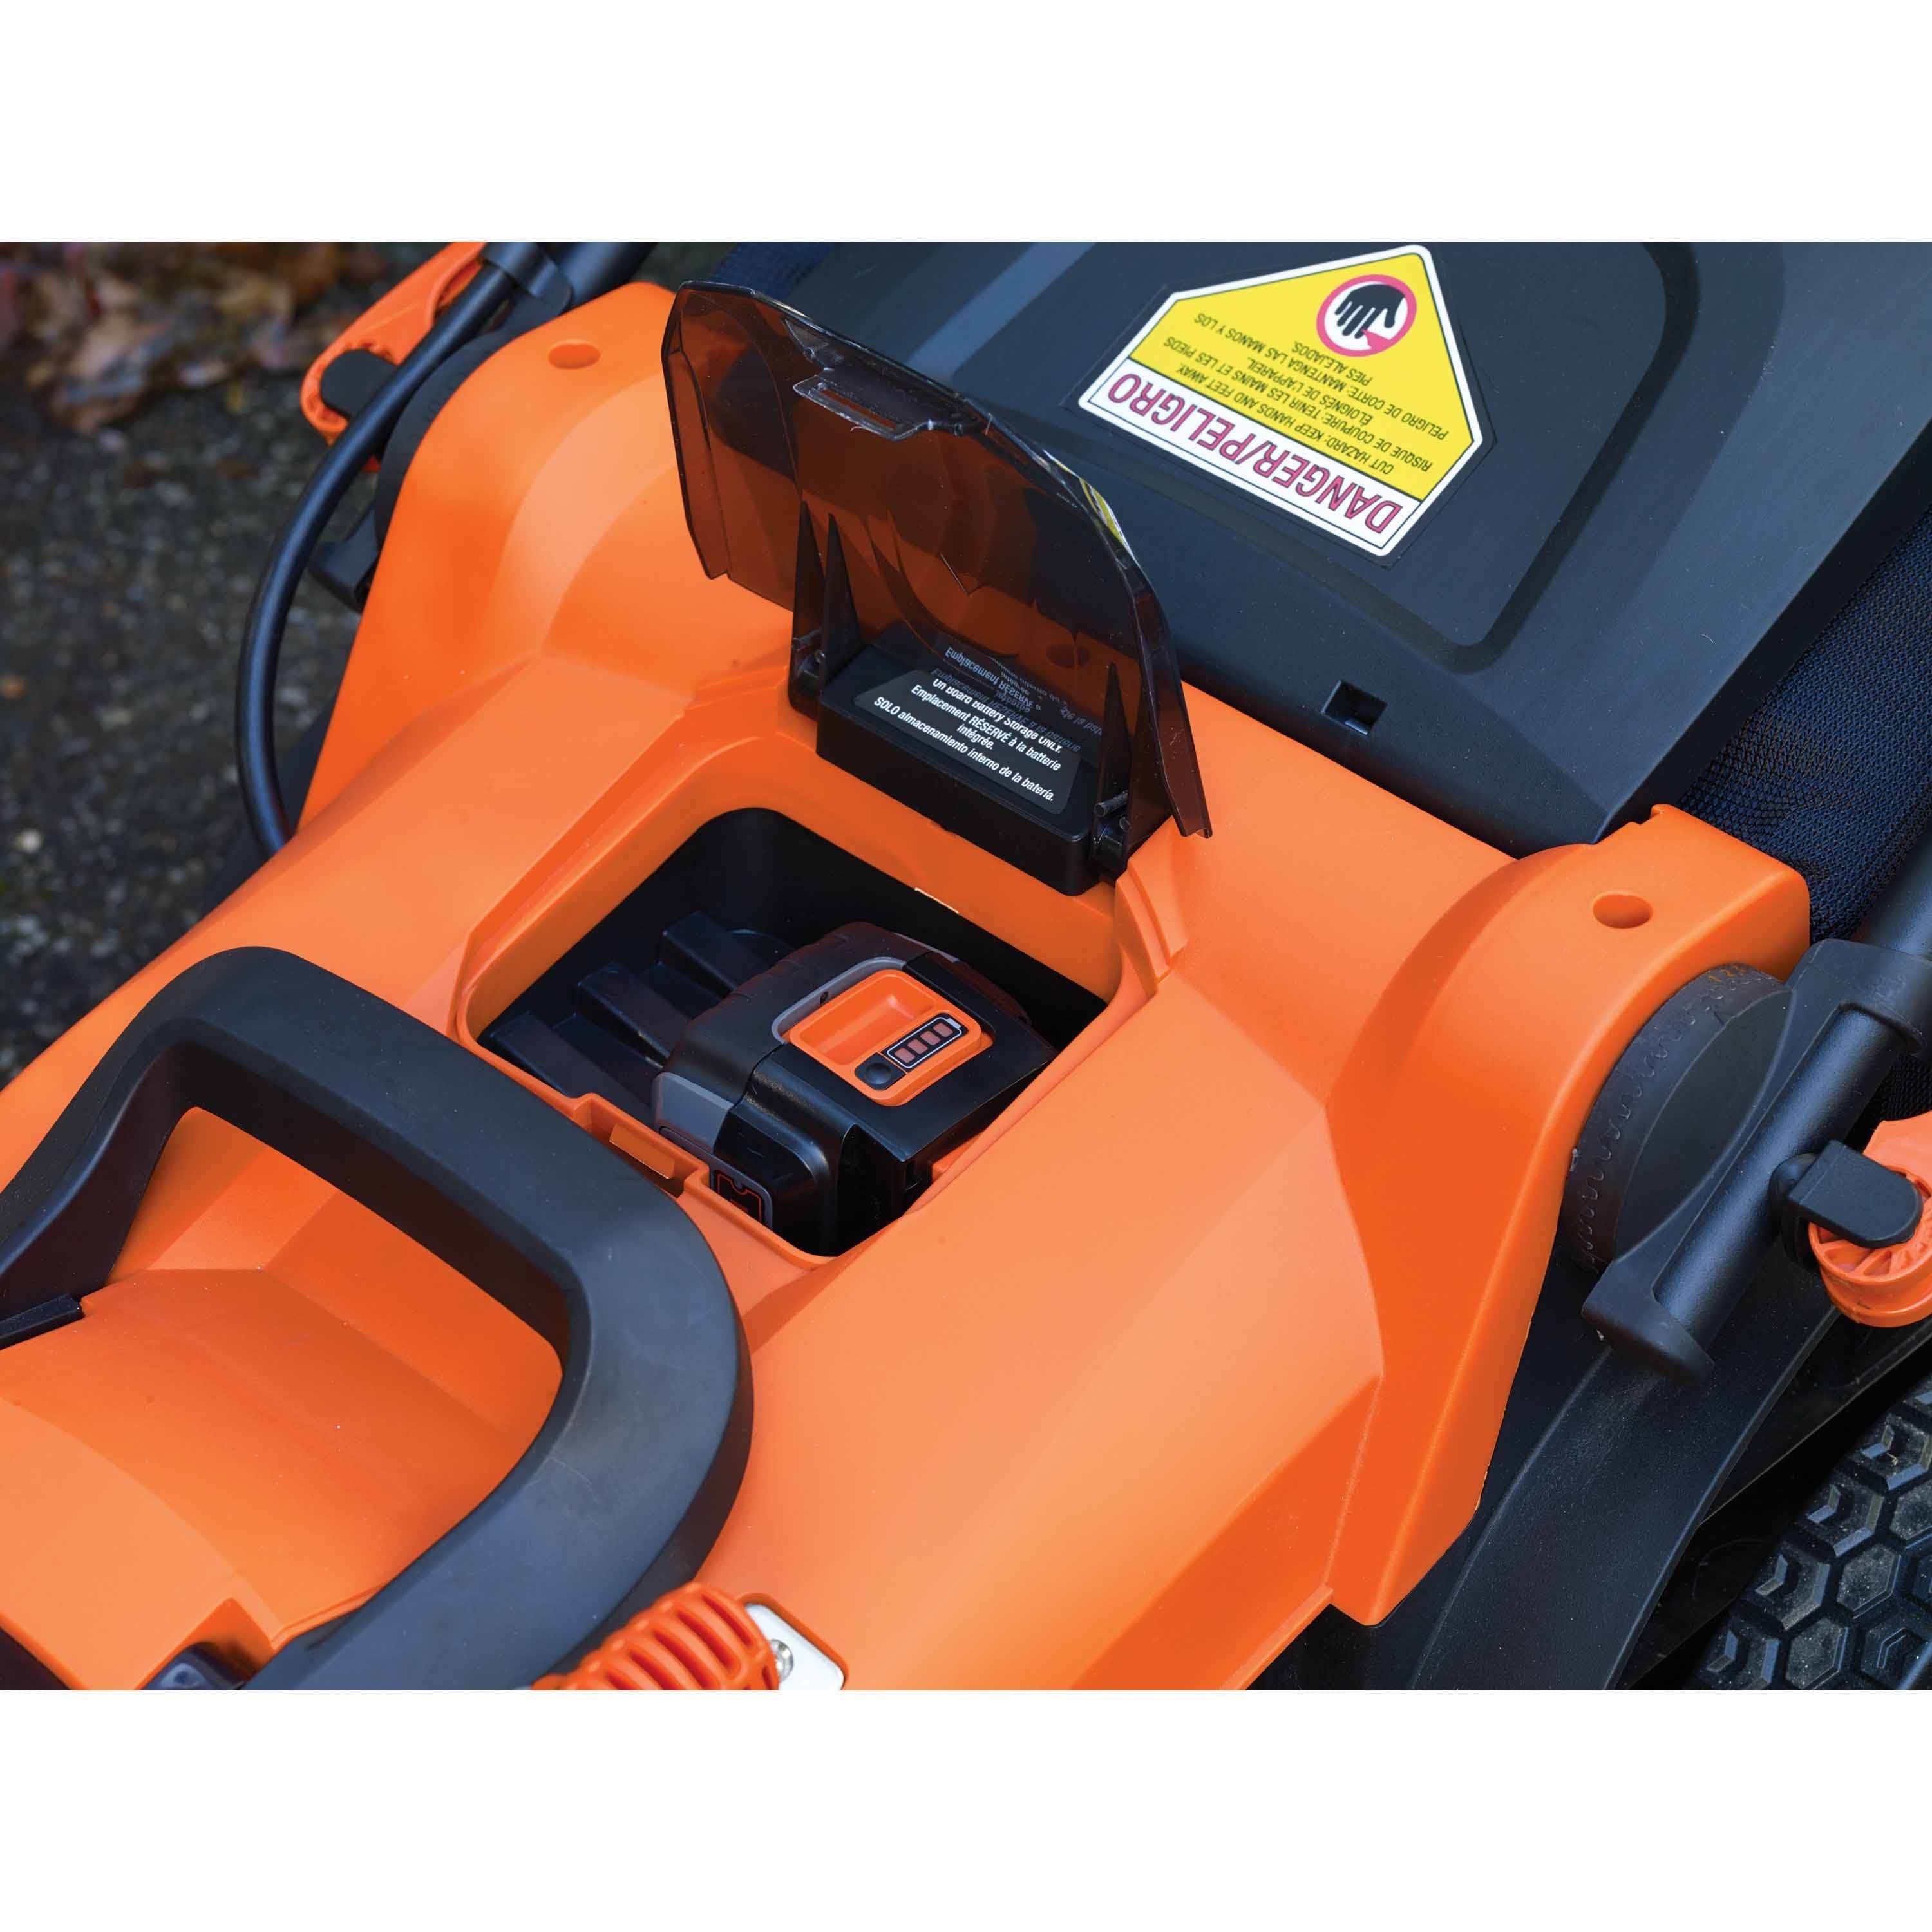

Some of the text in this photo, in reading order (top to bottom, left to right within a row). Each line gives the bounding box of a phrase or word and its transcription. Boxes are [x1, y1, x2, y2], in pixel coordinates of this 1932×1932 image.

[1194, 313, 1218, 329] LOS
[1216, 325, 1225, 334] Y
[1164, 336, 1196, 357] PIEDS
[1225, 328, 1265, 353] MANOS
[1195, 352, 1218, 368] LES
[1264, 347, 1288, 364] LAS
[1215, 363, 1233, 375] ET
[1287, 358, 1347, 392] MANTENGA
[1345, 368, 1372, 386] PIES
[1205, 379, 1234, 397] FEET
[1231, 370, 1268, 393] MAINS
[1233, 392, 1258, 408] AND
[1267, 388, 1290, 404] LES
[1302, 386, 1320, 400] DE
[1256, 403, 1296, 428] HANDS
[1289, 397, 1321, 419] TENIR
[1319, 394, 1373, 426] ÉLOIGNÉS
[1383, 404, 1403, 418] DE
[1294, 423, 1324, 441] KEEP
[1401, 412, 1448, 440] PELIGRO
[1108, 374, 1401, 532] DANGER/PELIGRO
[1324, 435, 1370, 464] HAZARD:
[1372, 437, 1392, 452] DE
[1368, 458, 1394, 474] CUT
[1390, 446, 1432, 471] RISQUE
[911, 685, 971, 721] Emplacement
[968, 715, 1010, 742] RÉSERVÉ
[1007, 737, 1017, 747] à
[1015, 741, 1027, 752] la
[1025, 746, 1061, 770] batterie
[956, 723, 994, 749] intégrée.
[874, 697, 1053, 800] SOLO almacenamiento interno de la batería.
